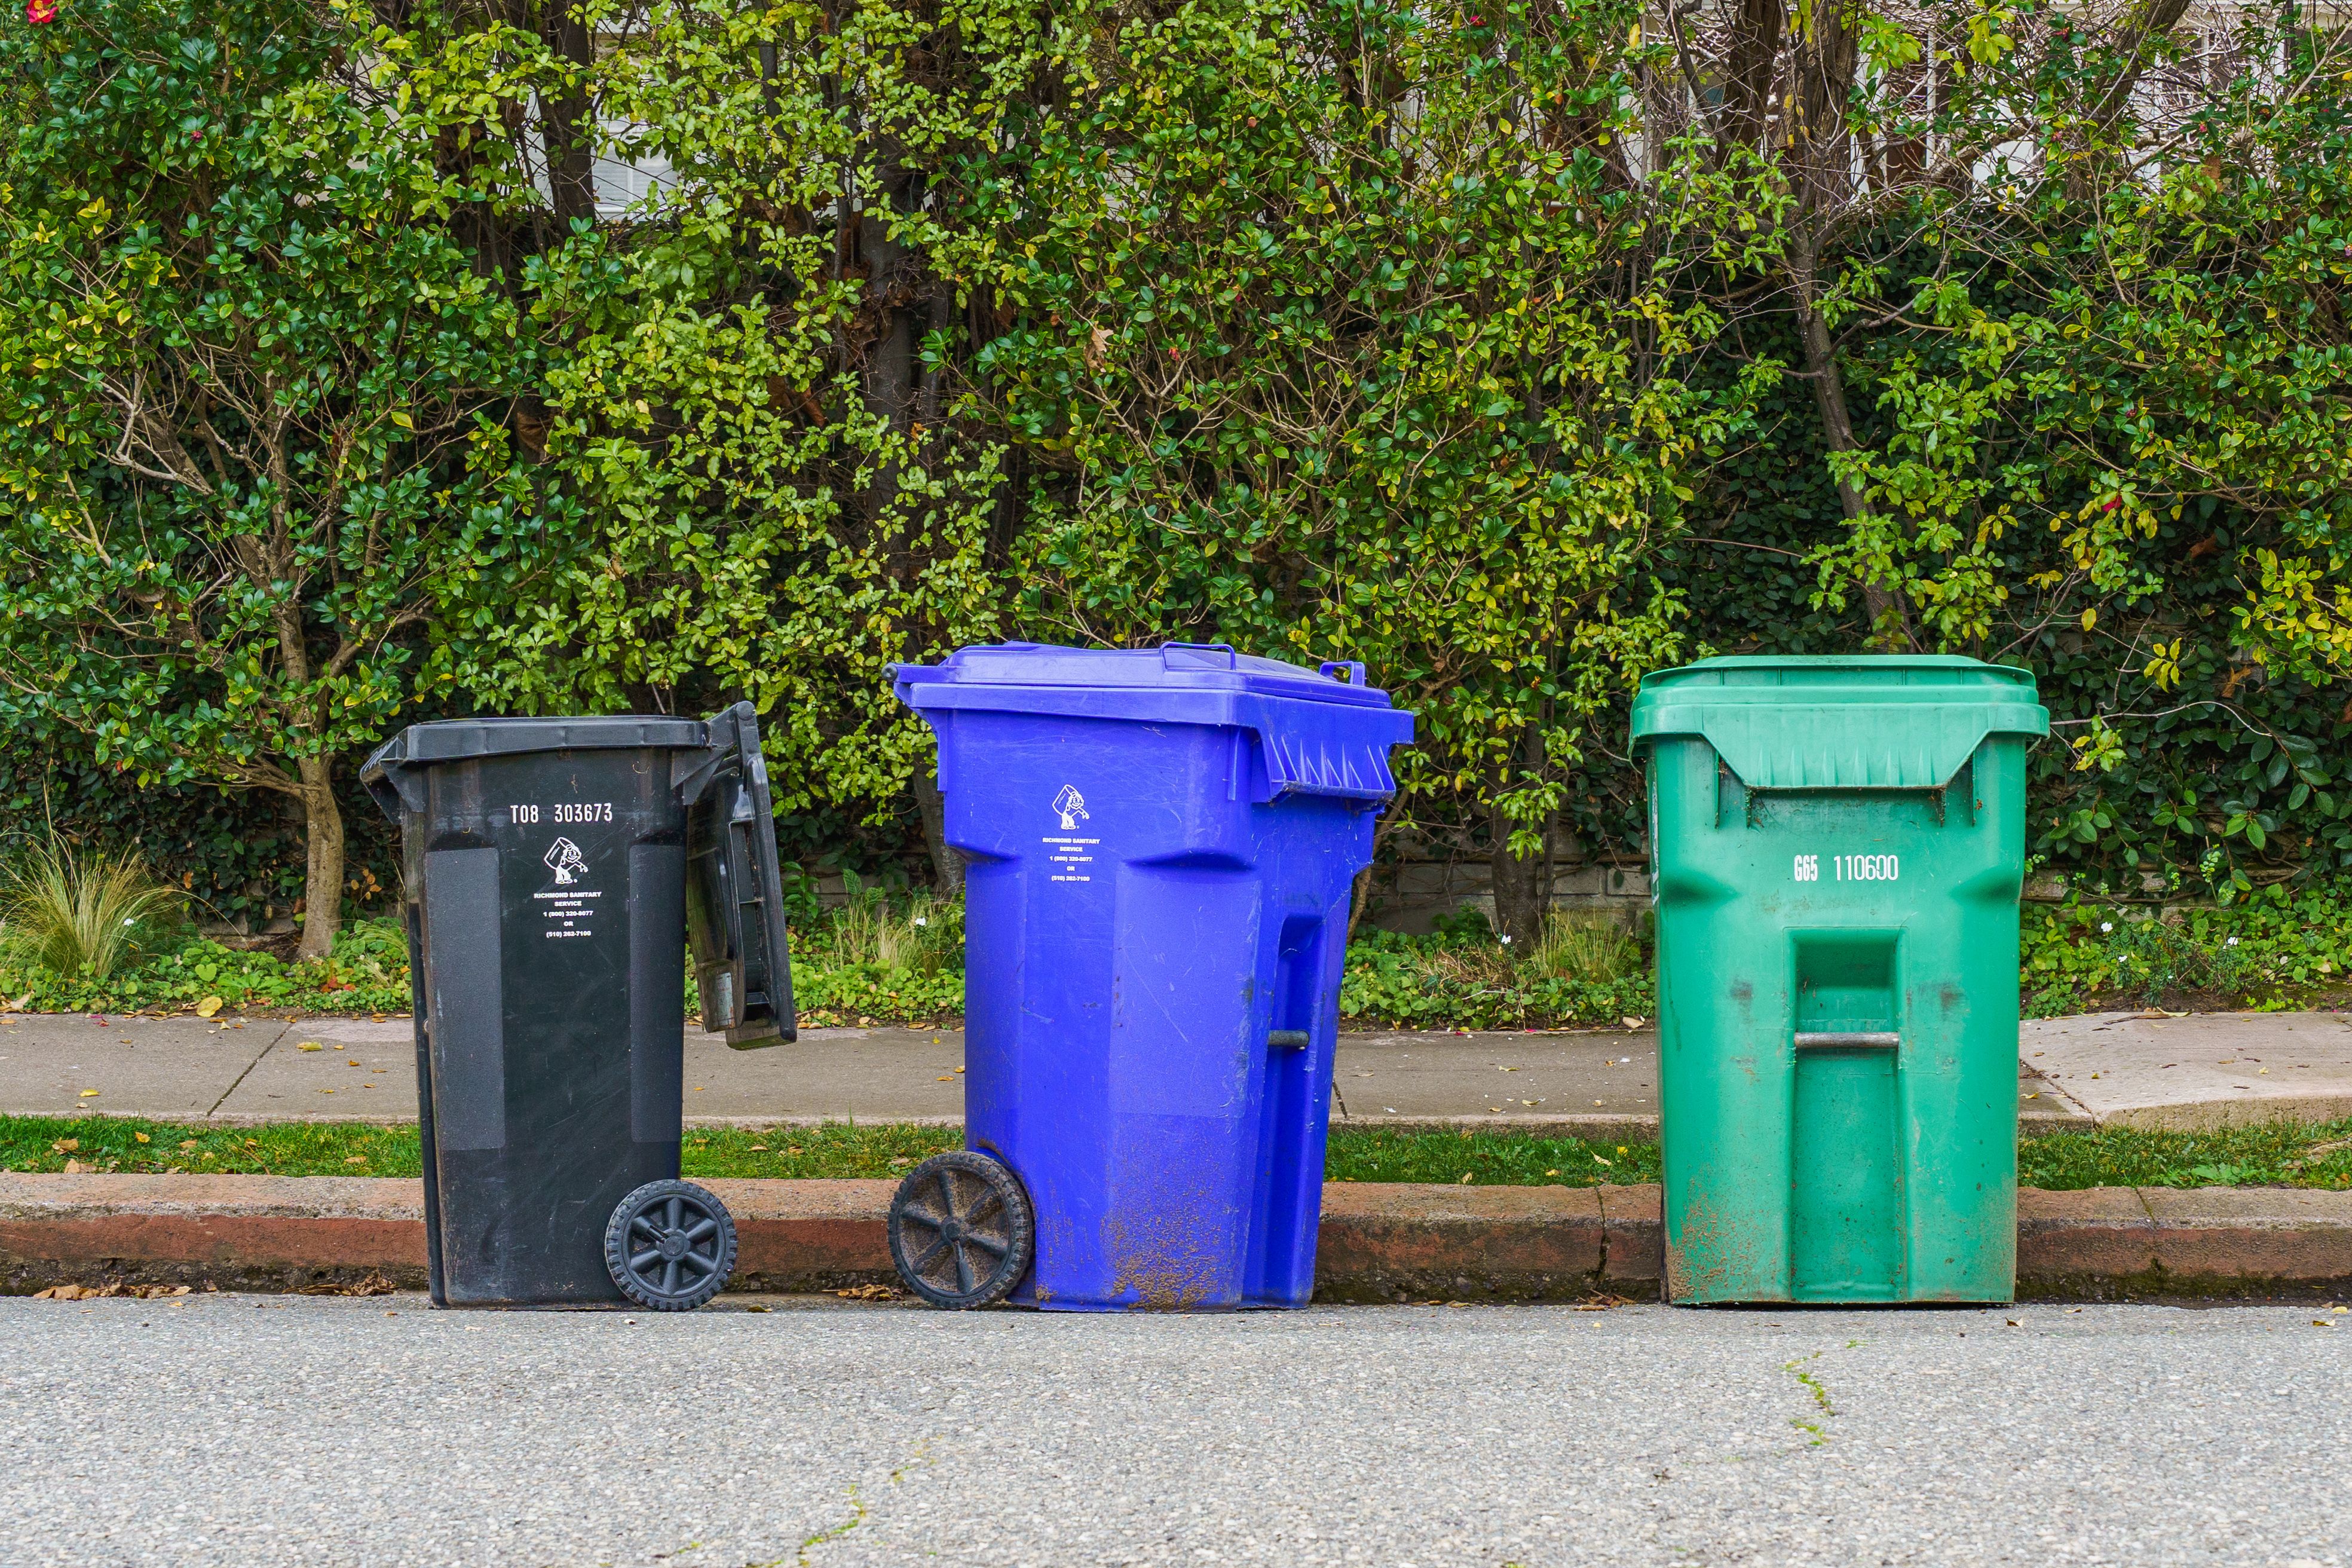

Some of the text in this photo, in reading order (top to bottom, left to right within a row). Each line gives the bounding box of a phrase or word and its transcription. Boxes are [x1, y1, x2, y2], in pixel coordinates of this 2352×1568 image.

[555, 803, 612, 822] 303673
[1794, 855, 1898, 881] G65 110600
